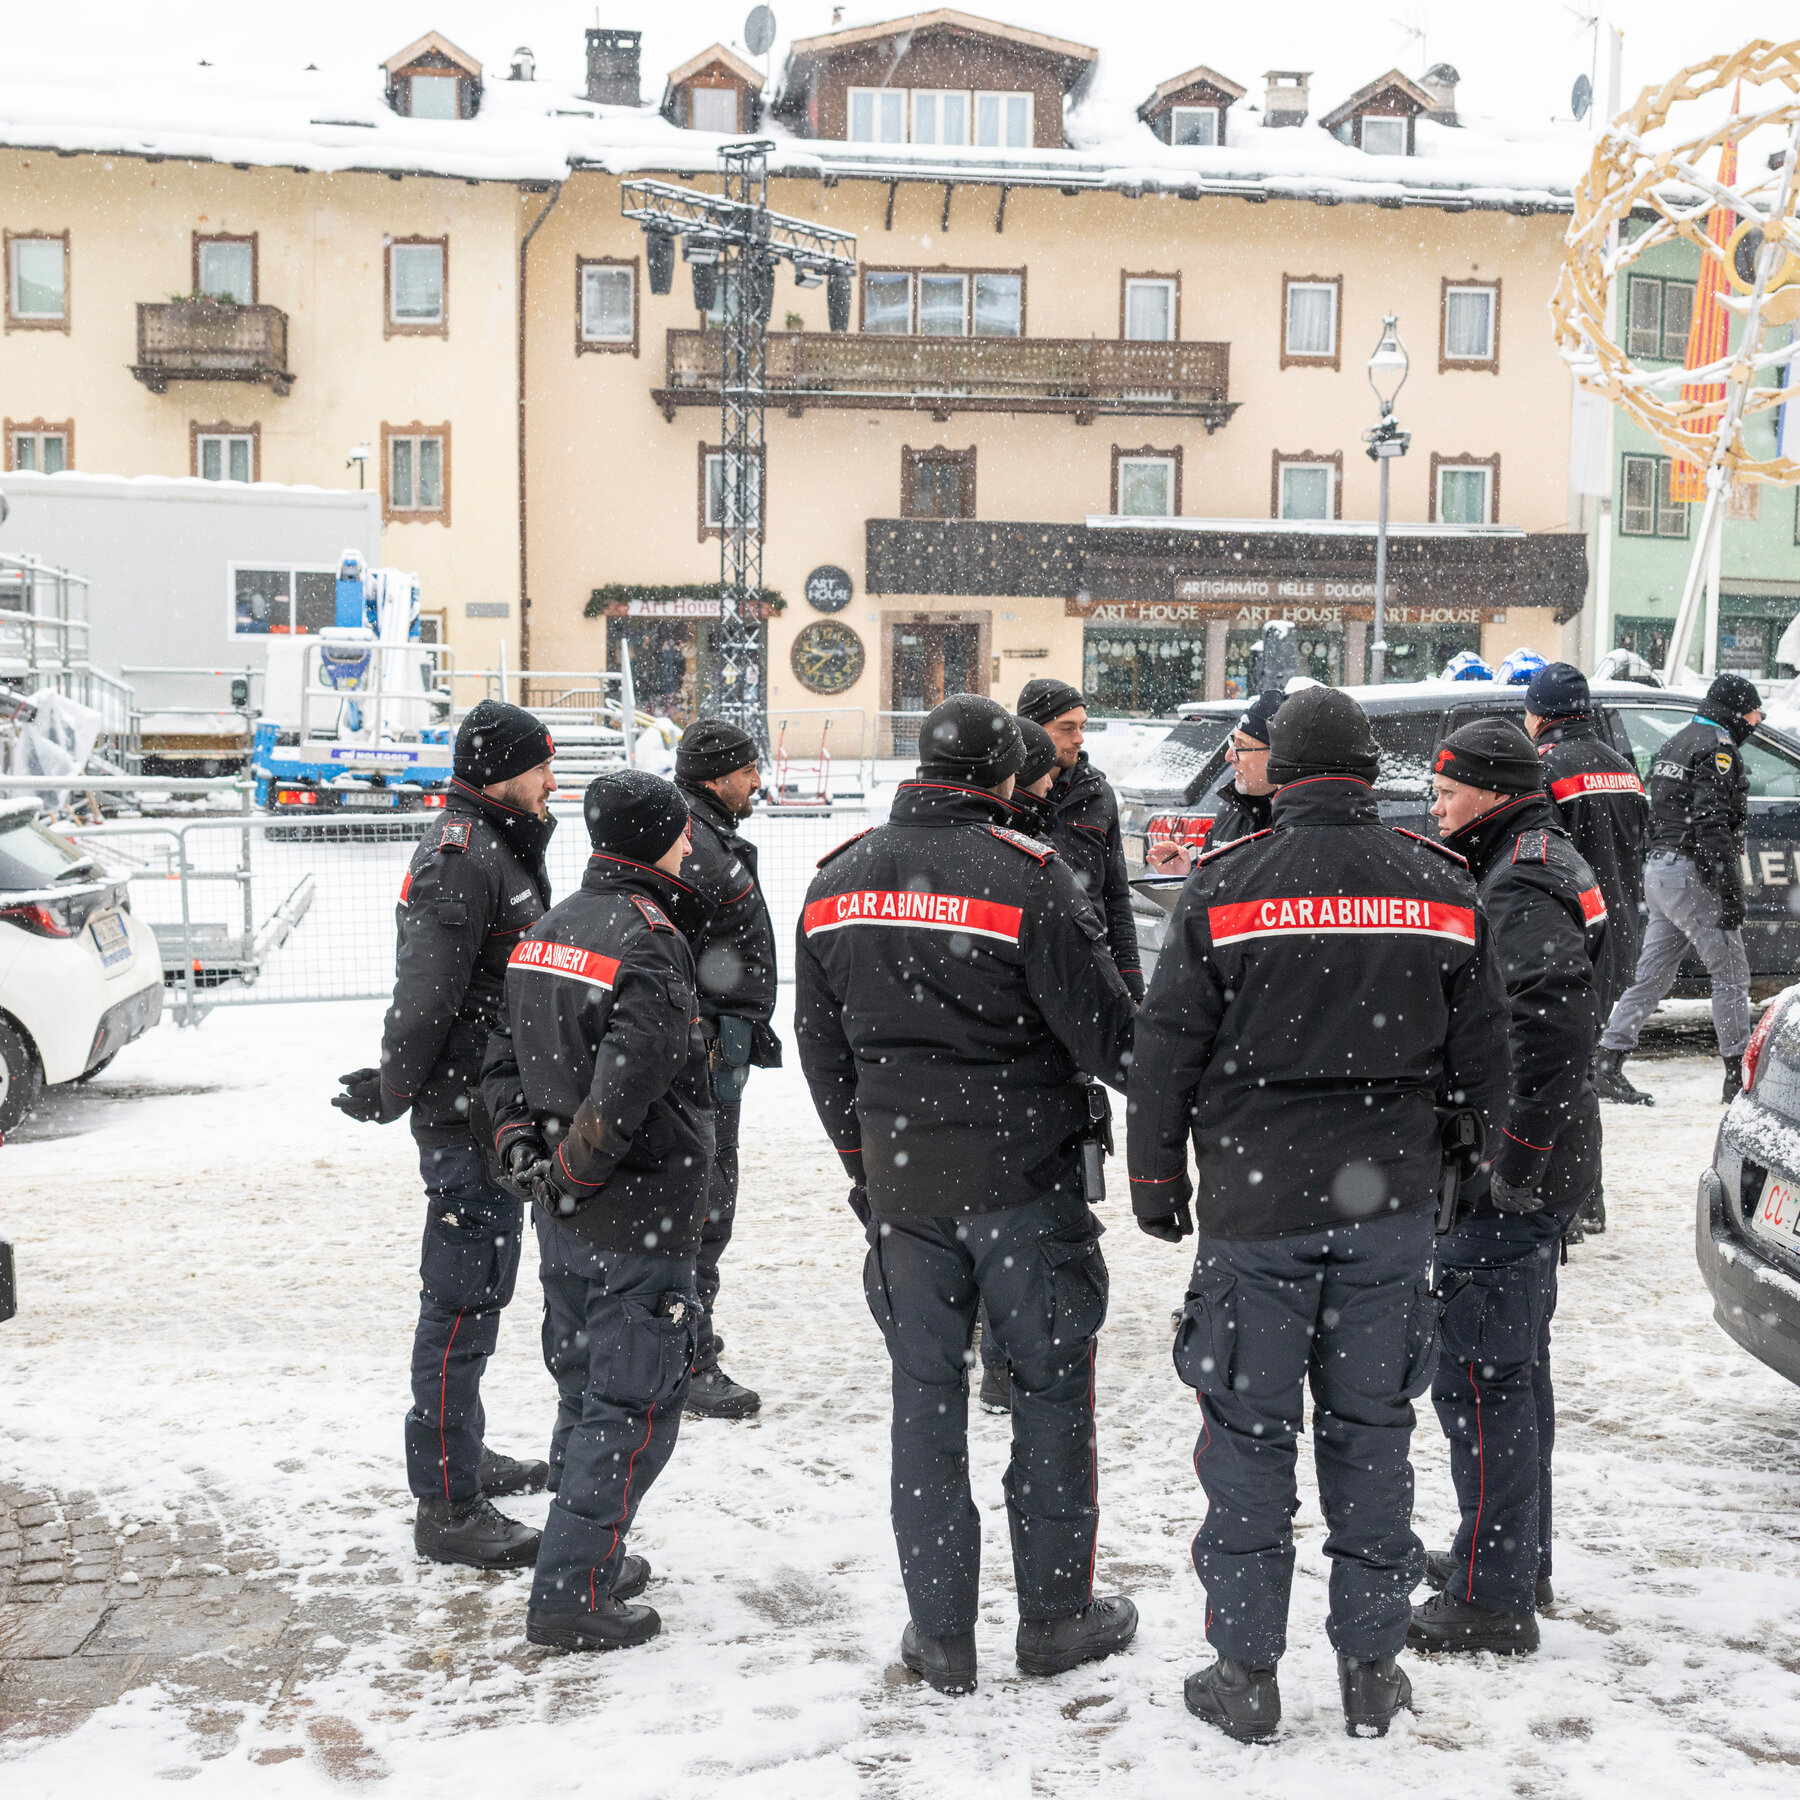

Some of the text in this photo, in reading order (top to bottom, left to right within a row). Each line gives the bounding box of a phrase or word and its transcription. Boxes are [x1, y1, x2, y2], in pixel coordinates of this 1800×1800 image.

[808, 578, 838, 590] ART
[1182, 581, 1389, 598] ARTIGIANATO NELLE DOLOMII
[808, 588, 850, 601] HOUSE
[639, 601, 668, 614] Art
[1091, 604, 1200, 621] ART HOUSE
[1236, 606, 1342, 622] ART HOUSE
[1420, 608, 1481, 623] HOUSE
[836, 892, 969, 924] CARABINIERI
[1260, 898, 1431, 927] CARABINIERI
